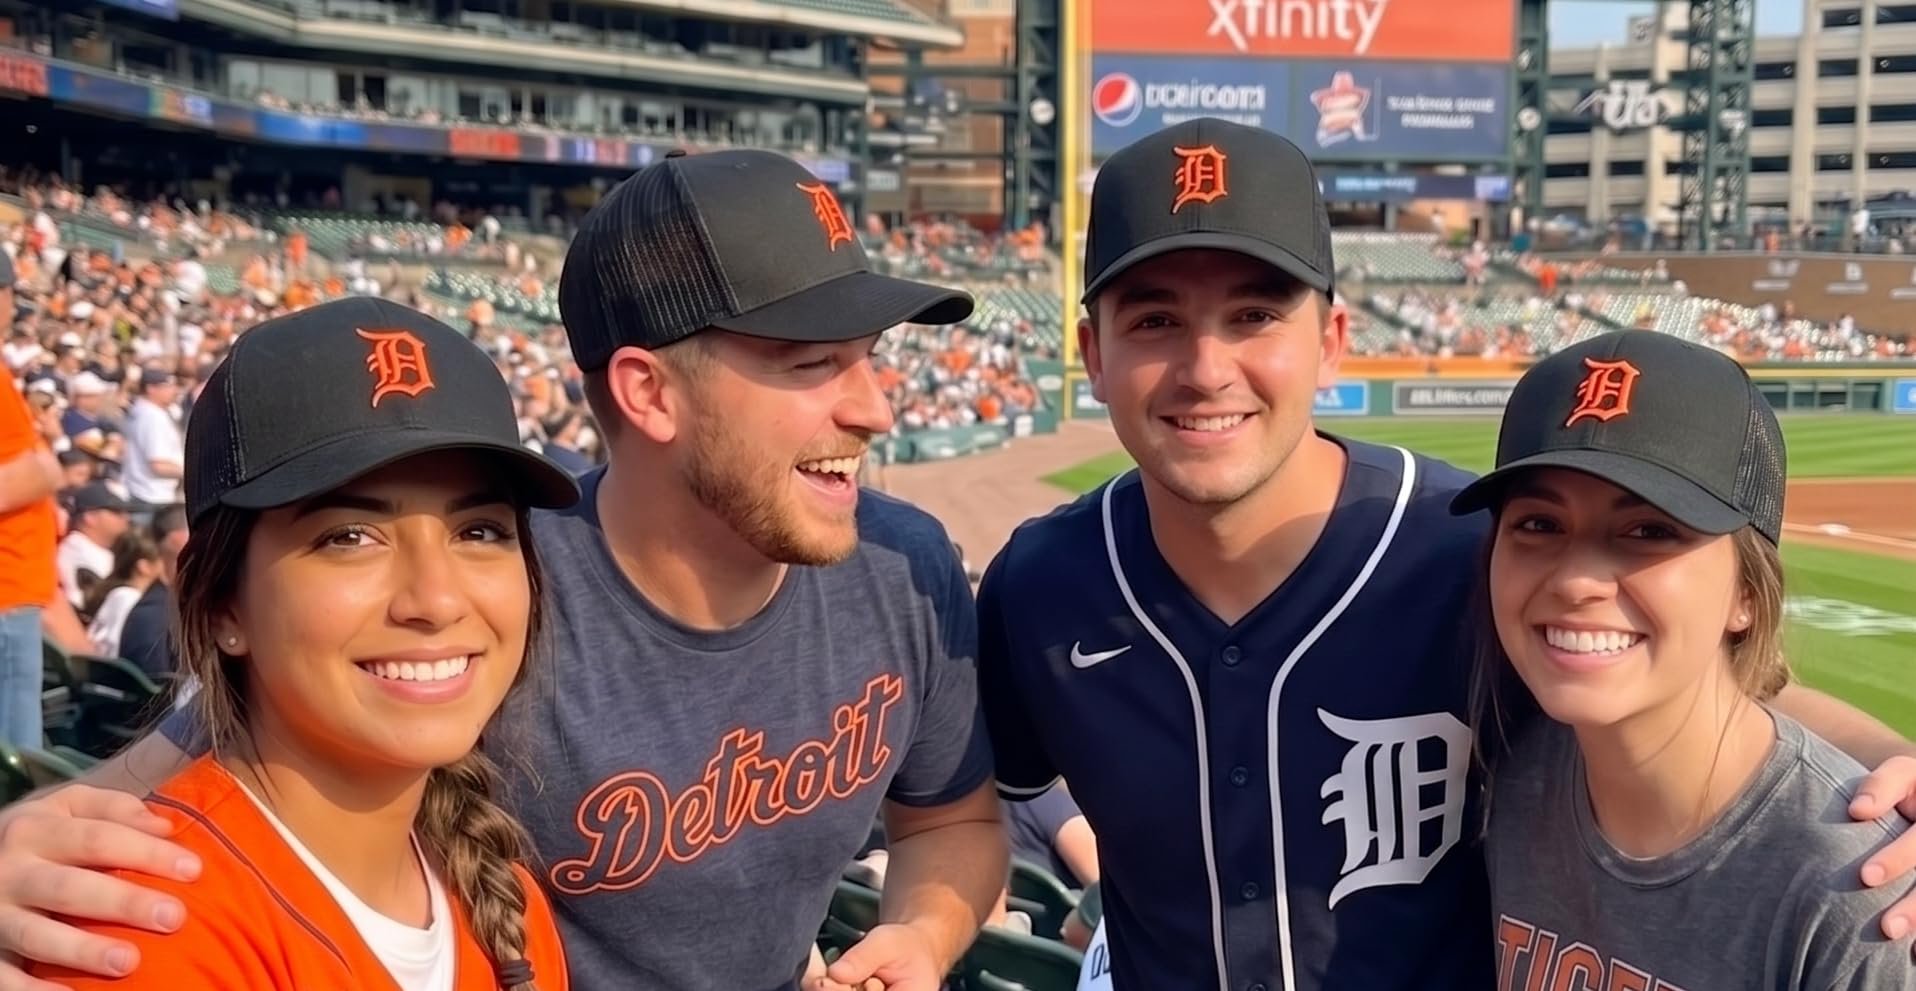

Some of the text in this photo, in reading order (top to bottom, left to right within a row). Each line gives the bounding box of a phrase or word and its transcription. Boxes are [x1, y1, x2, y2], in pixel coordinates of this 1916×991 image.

[1207, 0, 1387, 55] xfinity
[1172, 145, 1228, 214] D
[795, 181, 853, 252] D
[355, 328, 435, 408] D
[1566, 357, 1641, 427] D
[550, 673, 904, 895] Detroit
[1316, 706, 1473, 911] D
